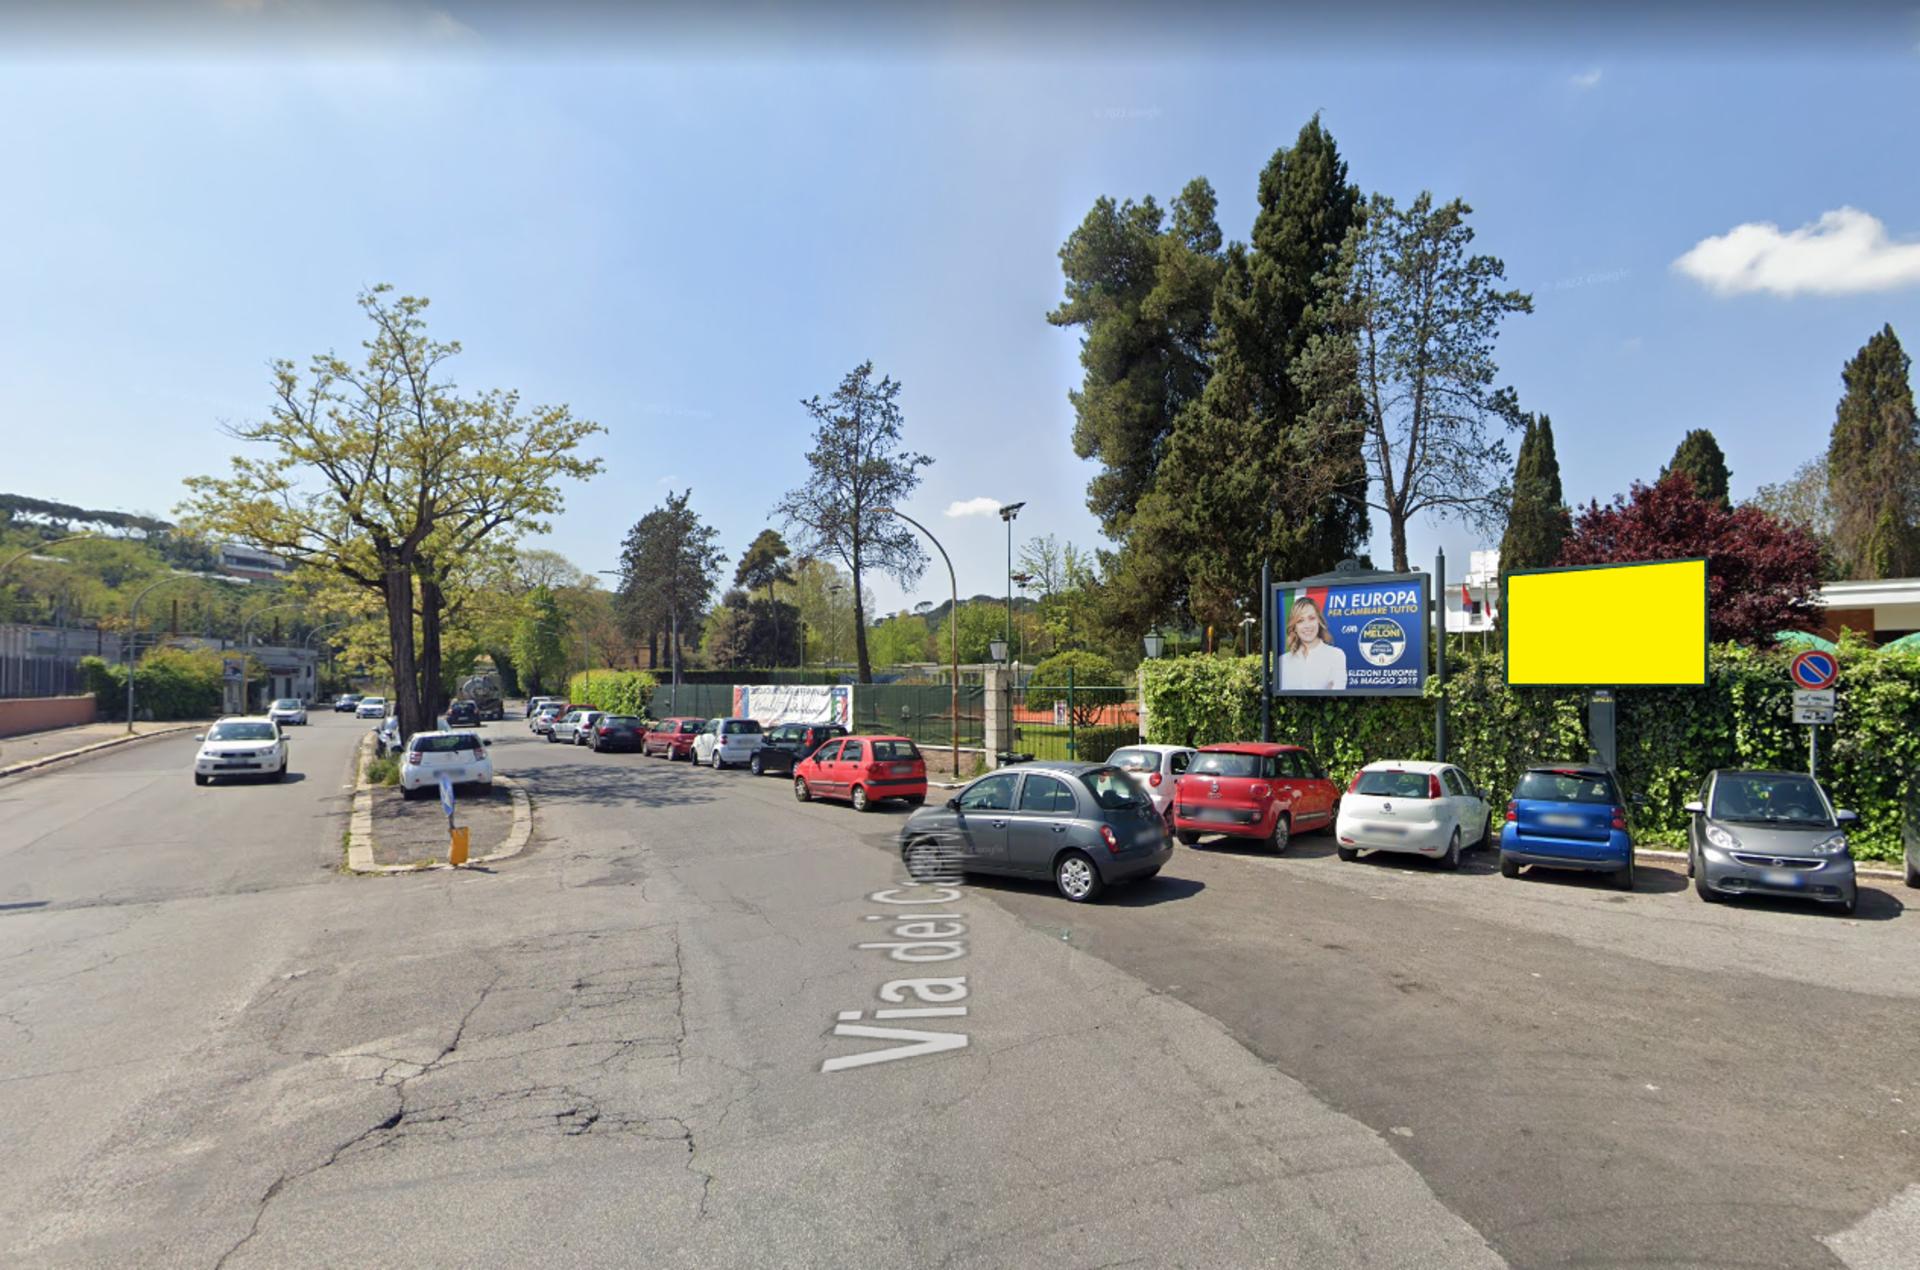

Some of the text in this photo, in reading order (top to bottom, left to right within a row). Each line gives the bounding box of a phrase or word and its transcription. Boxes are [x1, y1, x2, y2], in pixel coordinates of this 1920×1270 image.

[1329, 591, 1417, 608] IN EUROPA
[1328, 605, 1418, 616] PER CAMBIARE TUTTO
[1363, 629, 1400, 638] MELONI
[1350, 677, 1359, 685] 26
[1360, 677, 1396, 685] MAGGIO
